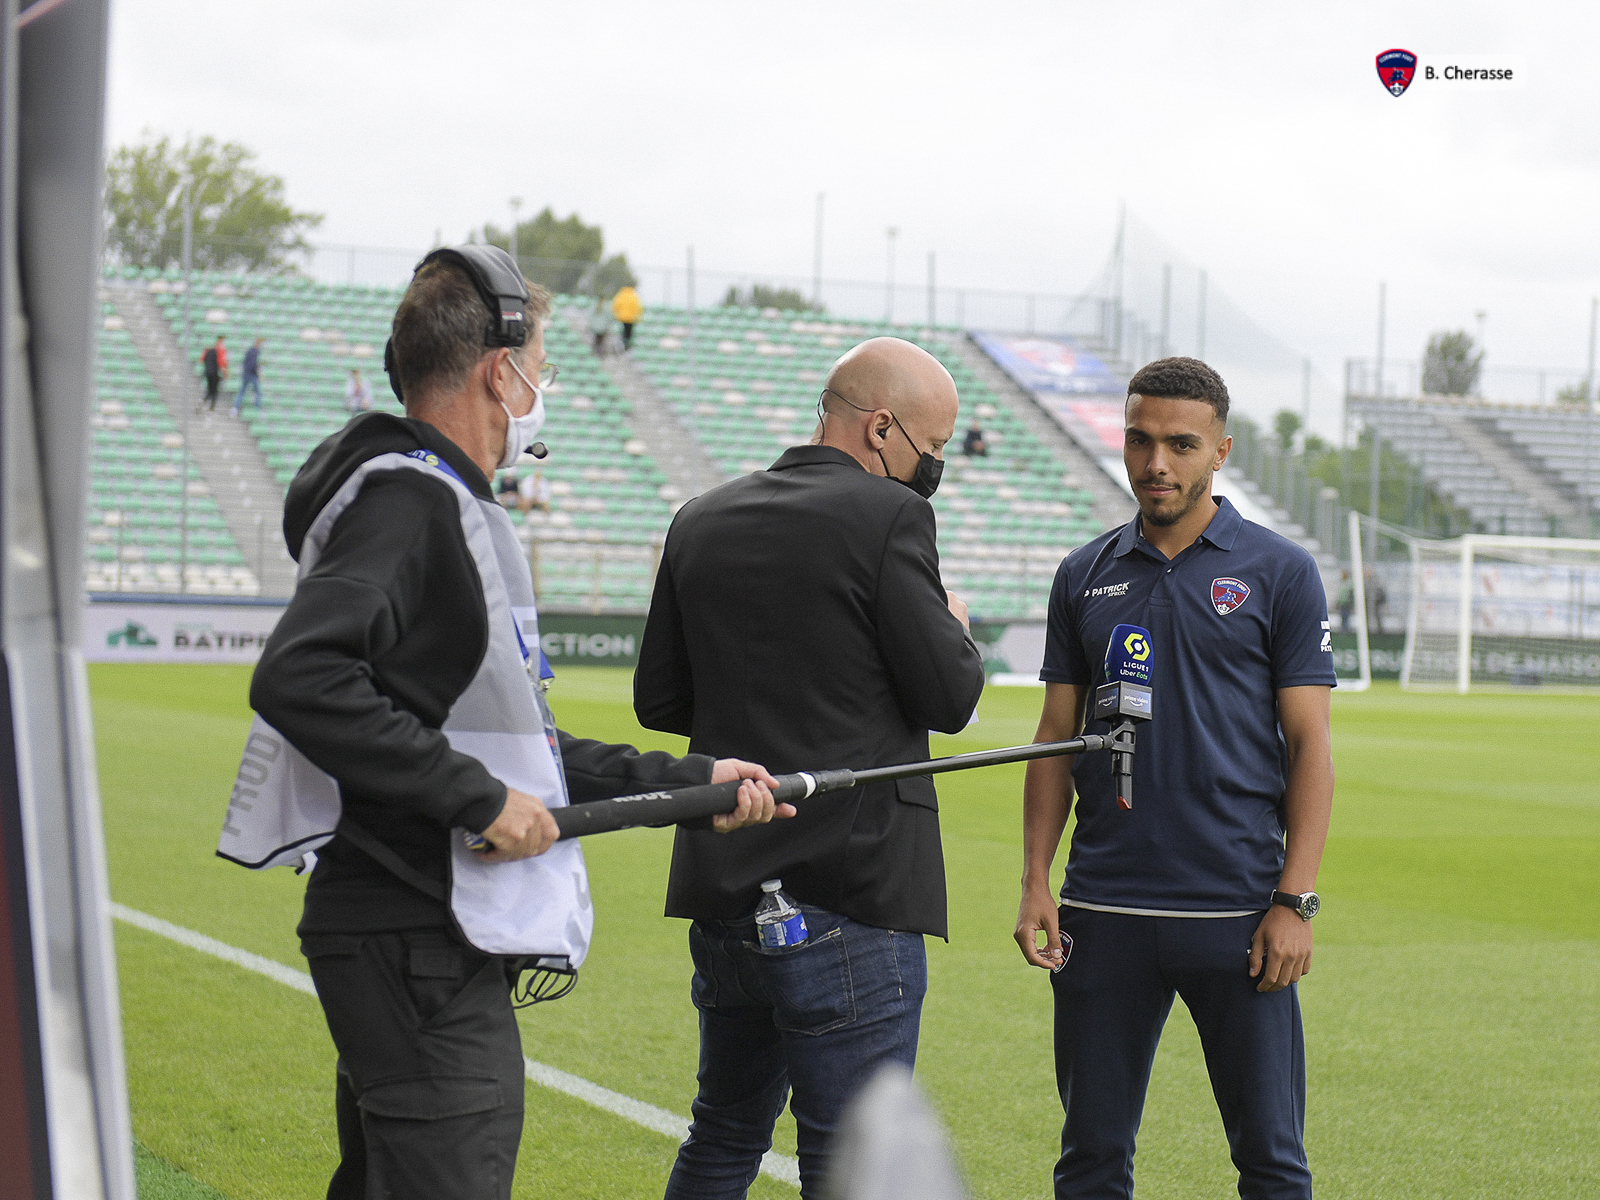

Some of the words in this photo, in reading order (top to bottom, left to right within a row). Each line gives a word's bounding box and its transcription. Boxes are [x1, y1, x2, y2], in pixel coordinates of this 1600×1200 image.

[1091, 582, 1130, 597] PATRICK
[1119, 668, 1136, 677] Uber
[1136, 671, 1149, 681] Eats
